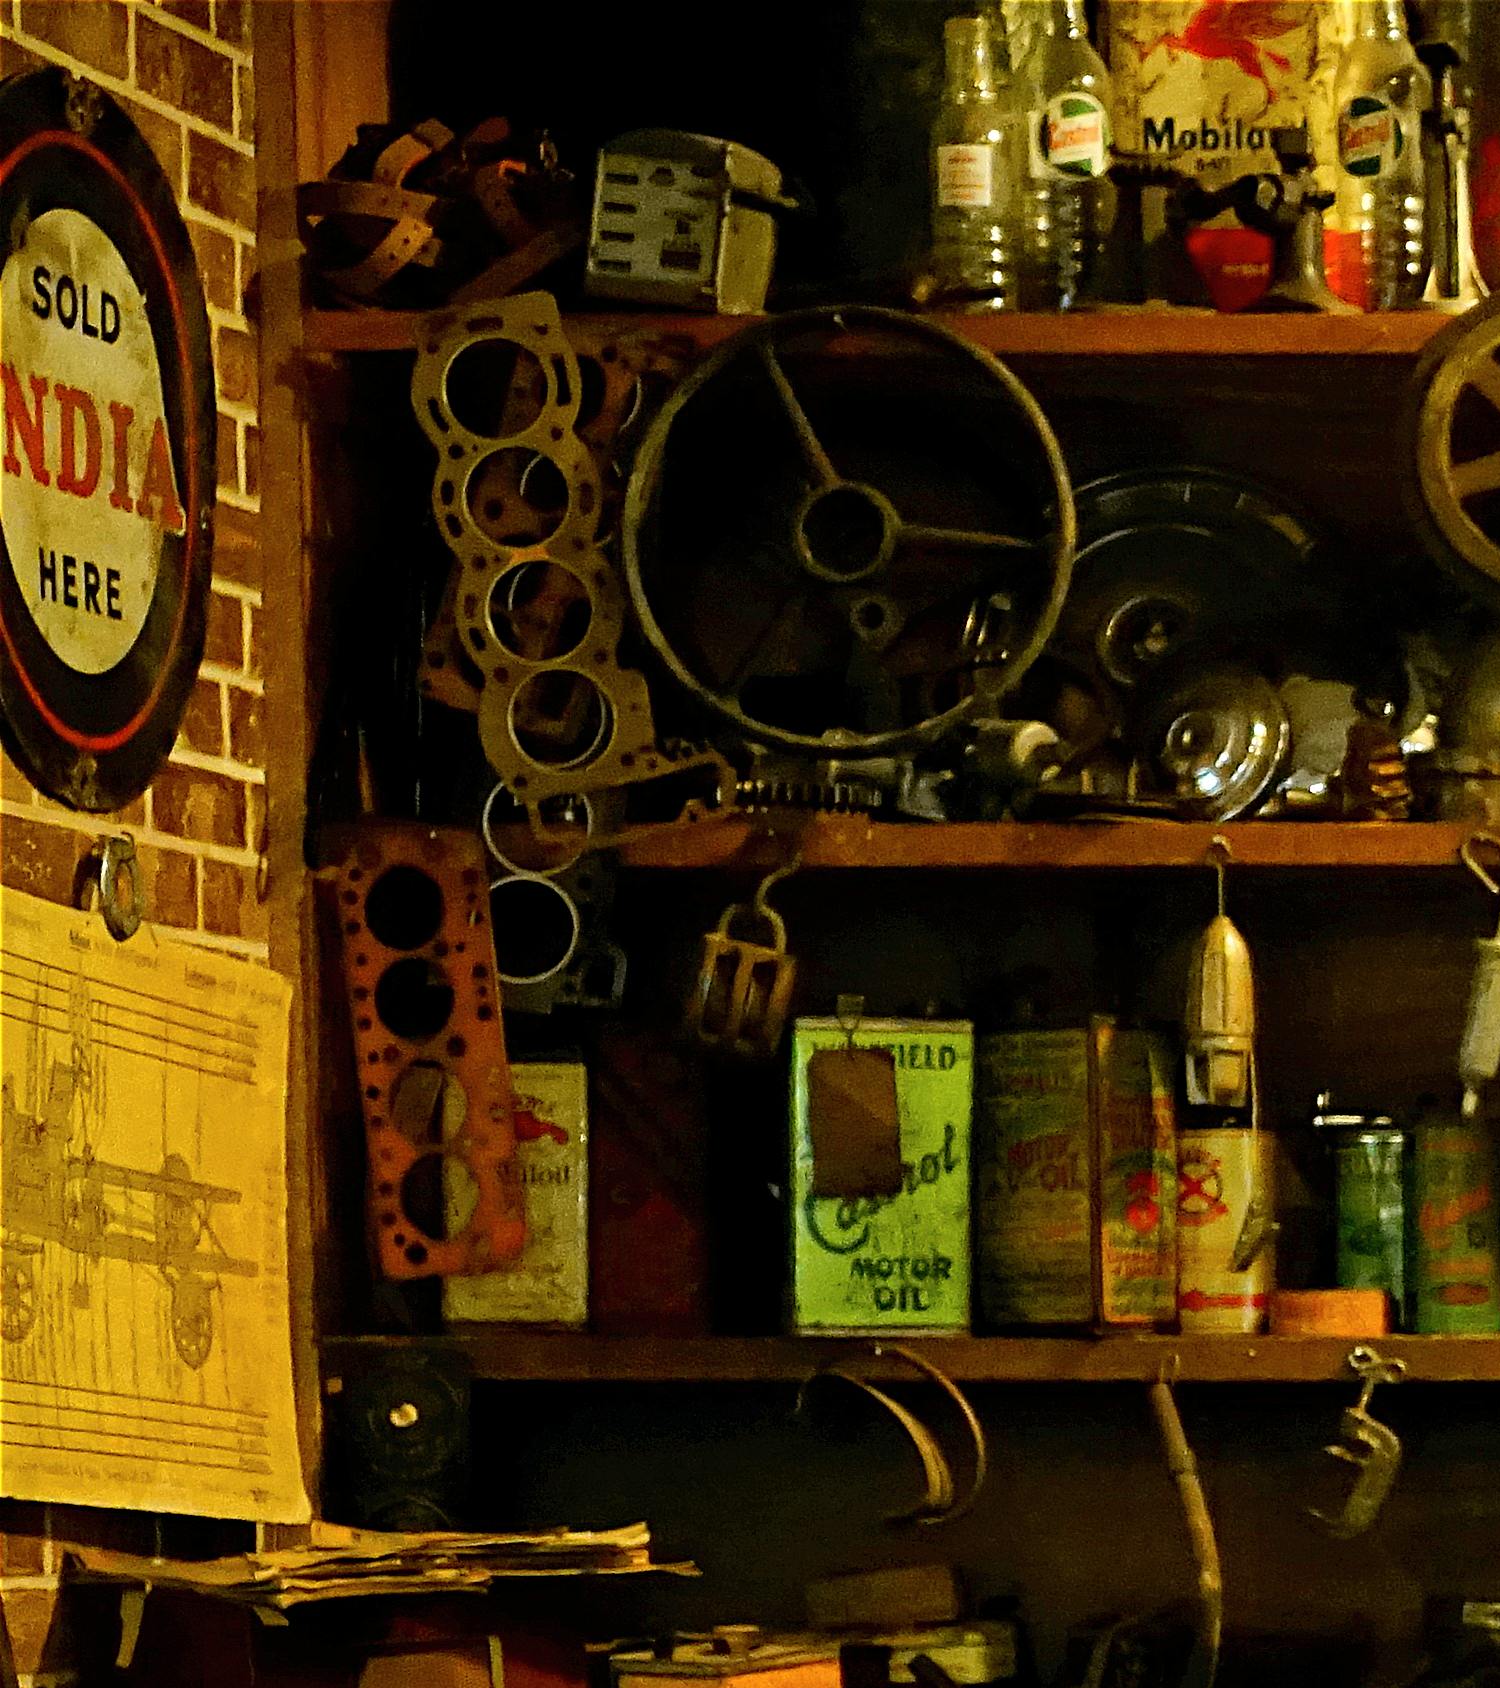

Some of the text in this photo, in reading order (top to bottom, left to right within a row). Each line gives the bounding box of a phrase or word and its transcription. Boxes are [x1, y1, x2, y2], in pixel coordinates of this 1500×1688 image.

[32, 266, 121, 345] SOLD
[38, 546, 123, 620] HERE
[851, 1257, 952, 1280] MOTOR
[875, 1286, 930, 1312] OIL
